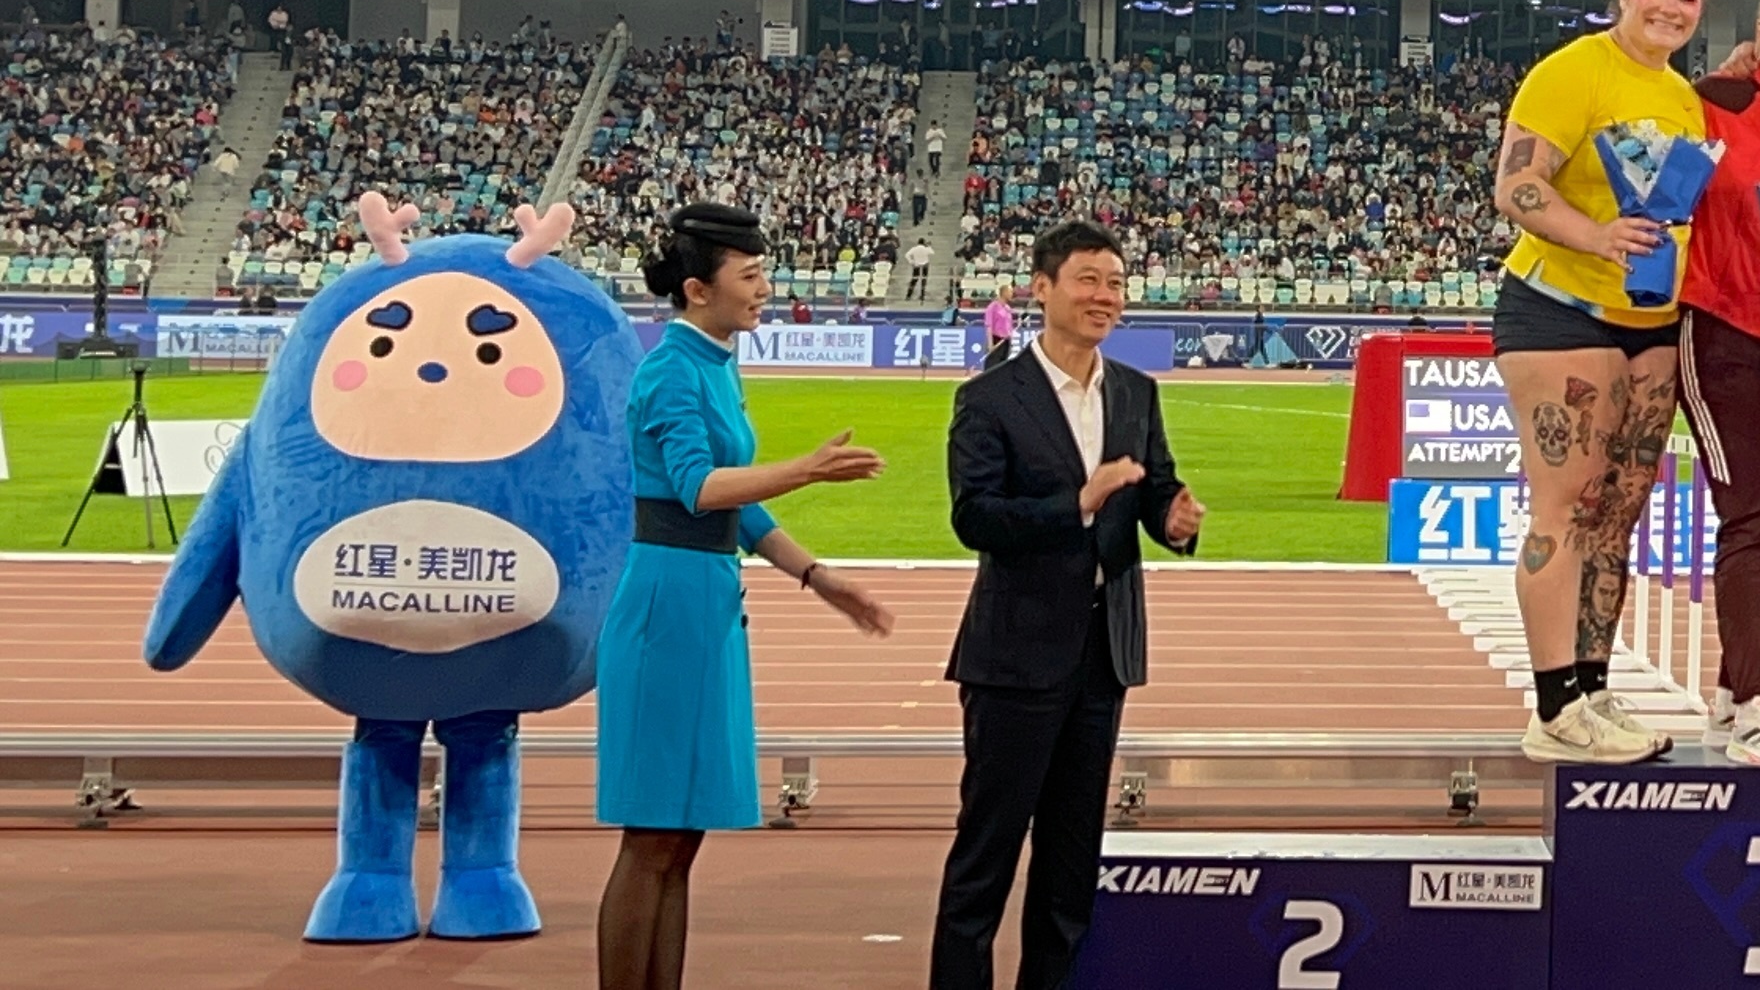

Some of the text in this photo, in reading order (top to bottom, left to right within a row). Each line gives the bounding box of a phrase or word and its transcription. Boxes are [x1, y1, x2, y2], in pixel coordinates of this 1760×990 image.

[747, 331, 782, 361] M
[784, 352, 866, 362] MACALLINE
[1403, 359, 1505, 388] TAUSA
[1454, 403, 1515, 431] USA
[1407, 441, 1522, 473] ATTEMPT 2
[334, 544, 517, 582] 红星·美凯龙
[332, 590, 516, 613] MACALLINE
[1566, 780, 1735, 811] XIAMEN
[1098, 866, 1261, 896] XIAMEN
[1418, 872, 1452, 903] M
[1455, 890, 1536, 904] MACALLINE
[1278, 899, 1344, 990] 2
